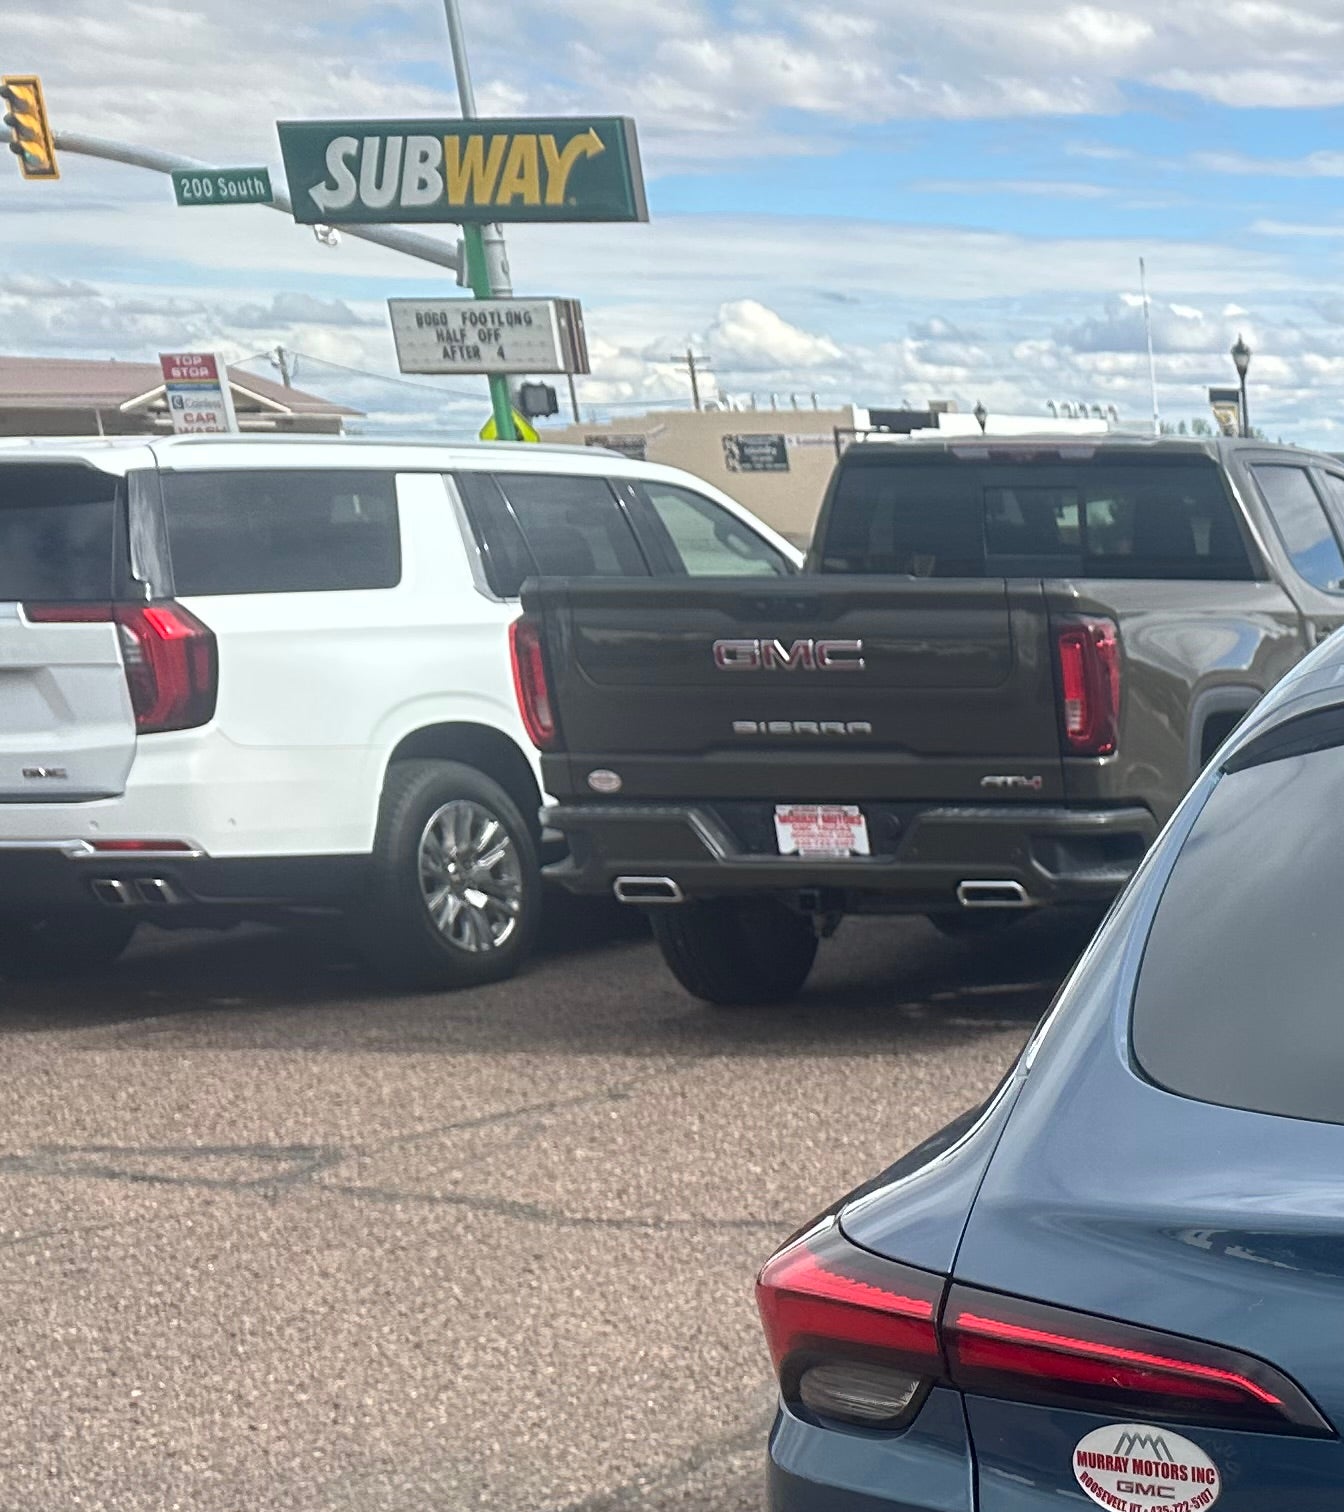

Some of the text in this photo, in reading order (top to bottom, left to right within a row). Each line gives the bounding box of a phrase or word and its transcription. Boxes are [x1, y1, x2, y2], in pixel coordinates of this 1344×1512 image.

[308, 126, 605, 214] SUBWAY
[180, 176, 266, 199] 200 South
[415, 310, 533, 328] BOGO FOOTLONG
[436, 328, 502, 344] HALF OFF
[174, 355, 202, 366] TOP
[442, 345, 481, 361] AFTER
[171, 366, 209, 378] STOP
[183, 412, 217, 424] CAR
[712, 639, 865, 671] GMC
[732, 721, 872, 735] SIERRA
[1076, 1450, 1216, 1485] MURRAY MOTORS INC
[1116, 1480, 1176, 1499] GMC
